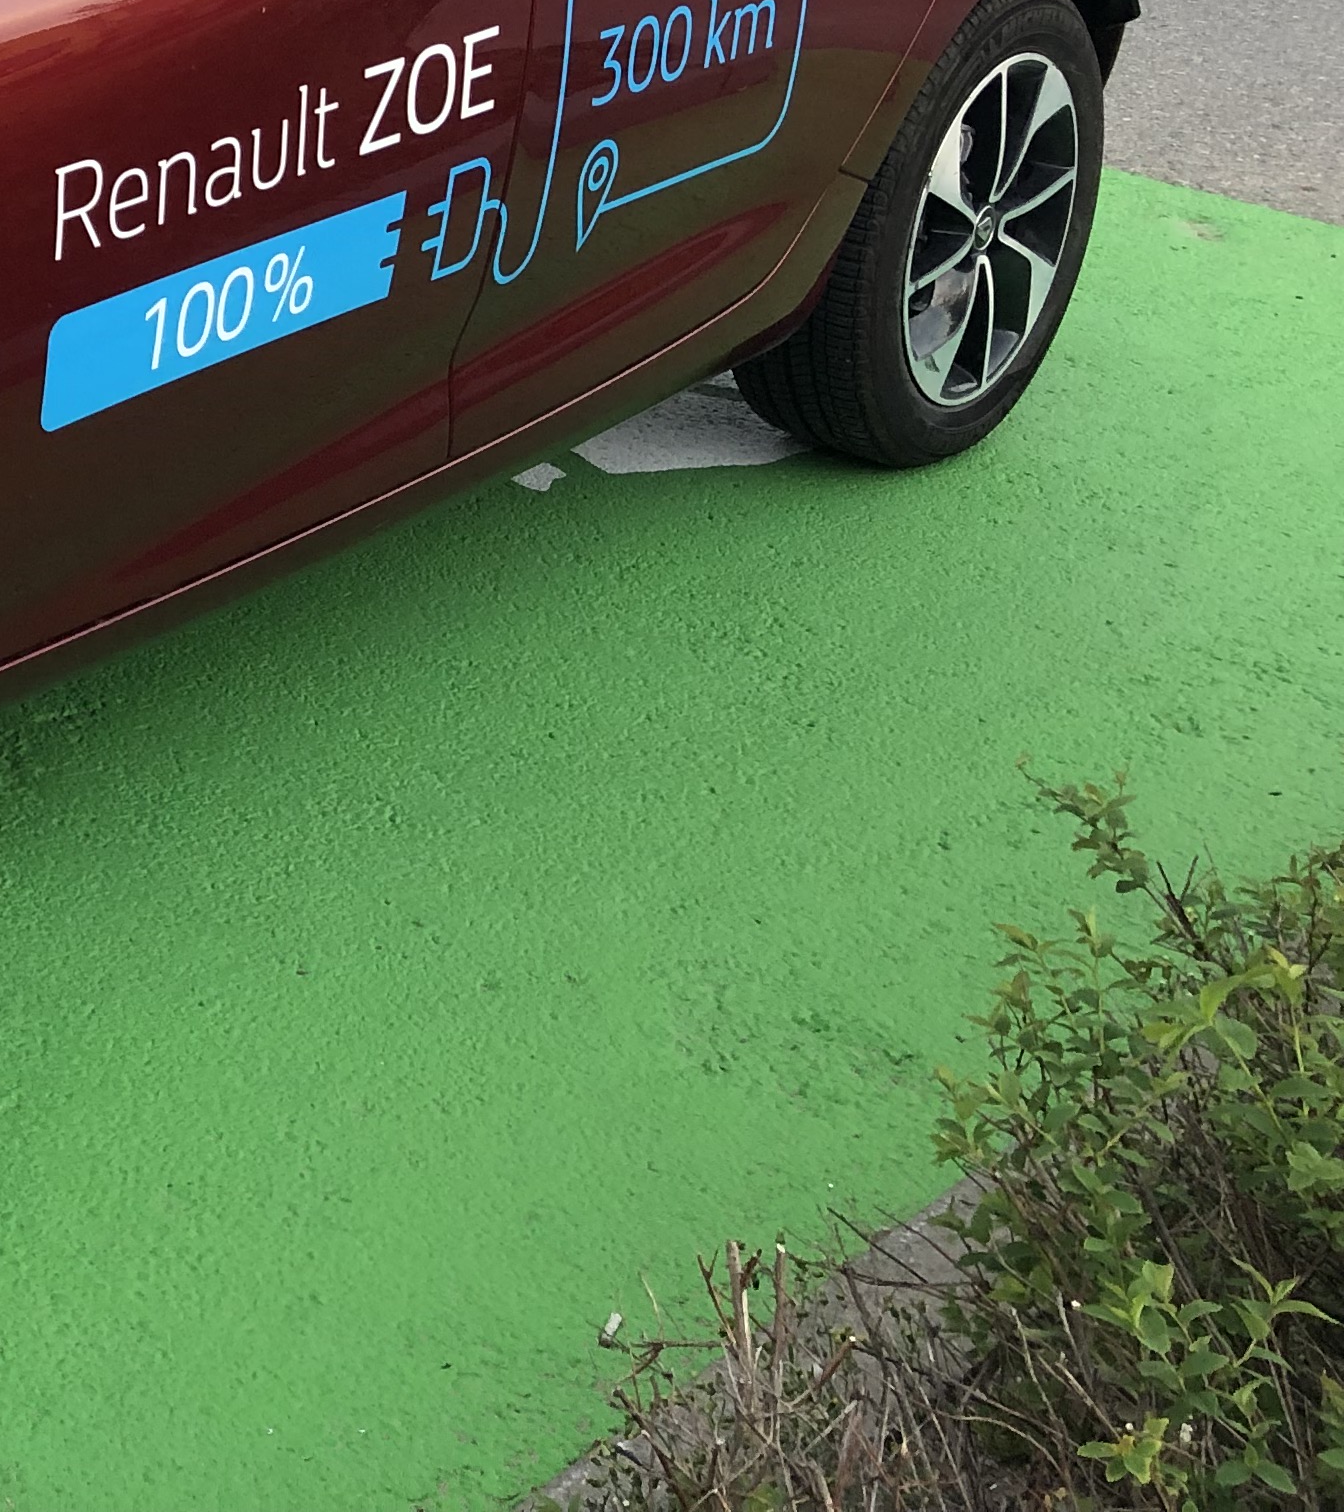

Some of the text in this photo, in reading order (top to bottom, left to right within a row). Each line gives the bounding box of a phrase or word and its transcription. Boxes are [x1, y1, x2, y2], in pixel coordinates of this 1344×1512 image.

[591, 4, 694, 107] 300
[54, 25, 501, 261] Renault ZOE
